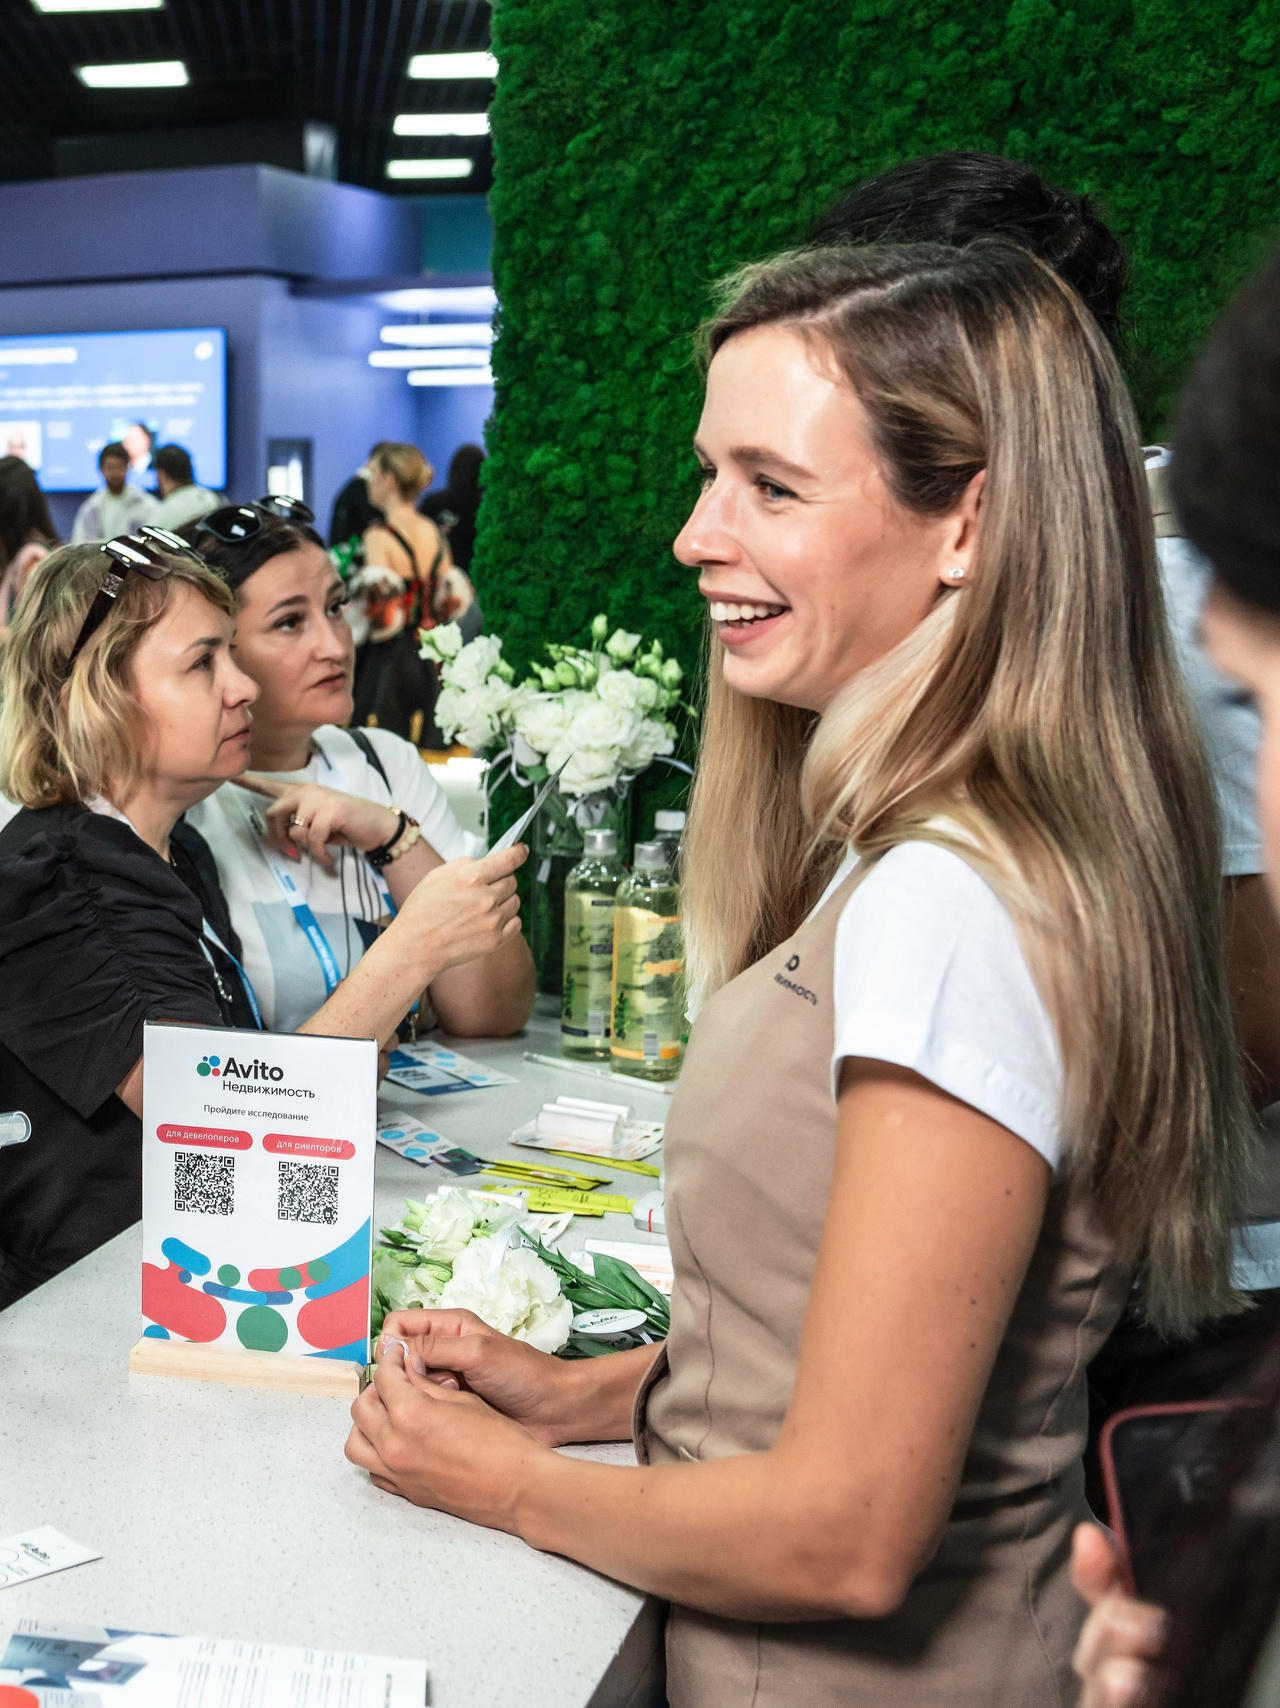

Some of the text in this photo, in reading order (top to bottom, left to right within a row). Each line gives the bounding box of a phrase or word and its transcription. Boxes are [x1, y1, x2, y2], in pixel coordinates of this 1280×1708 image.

[222, 1057, 284, 1082] Avito
[222, 1080, 316, 1099] Недвижимость
[203, 1104, 309, 1122] Пройдите исследование
[165, 1129, 240, 1144] для девелоперов
[276, 1141, 342, 1154] для риелторов
